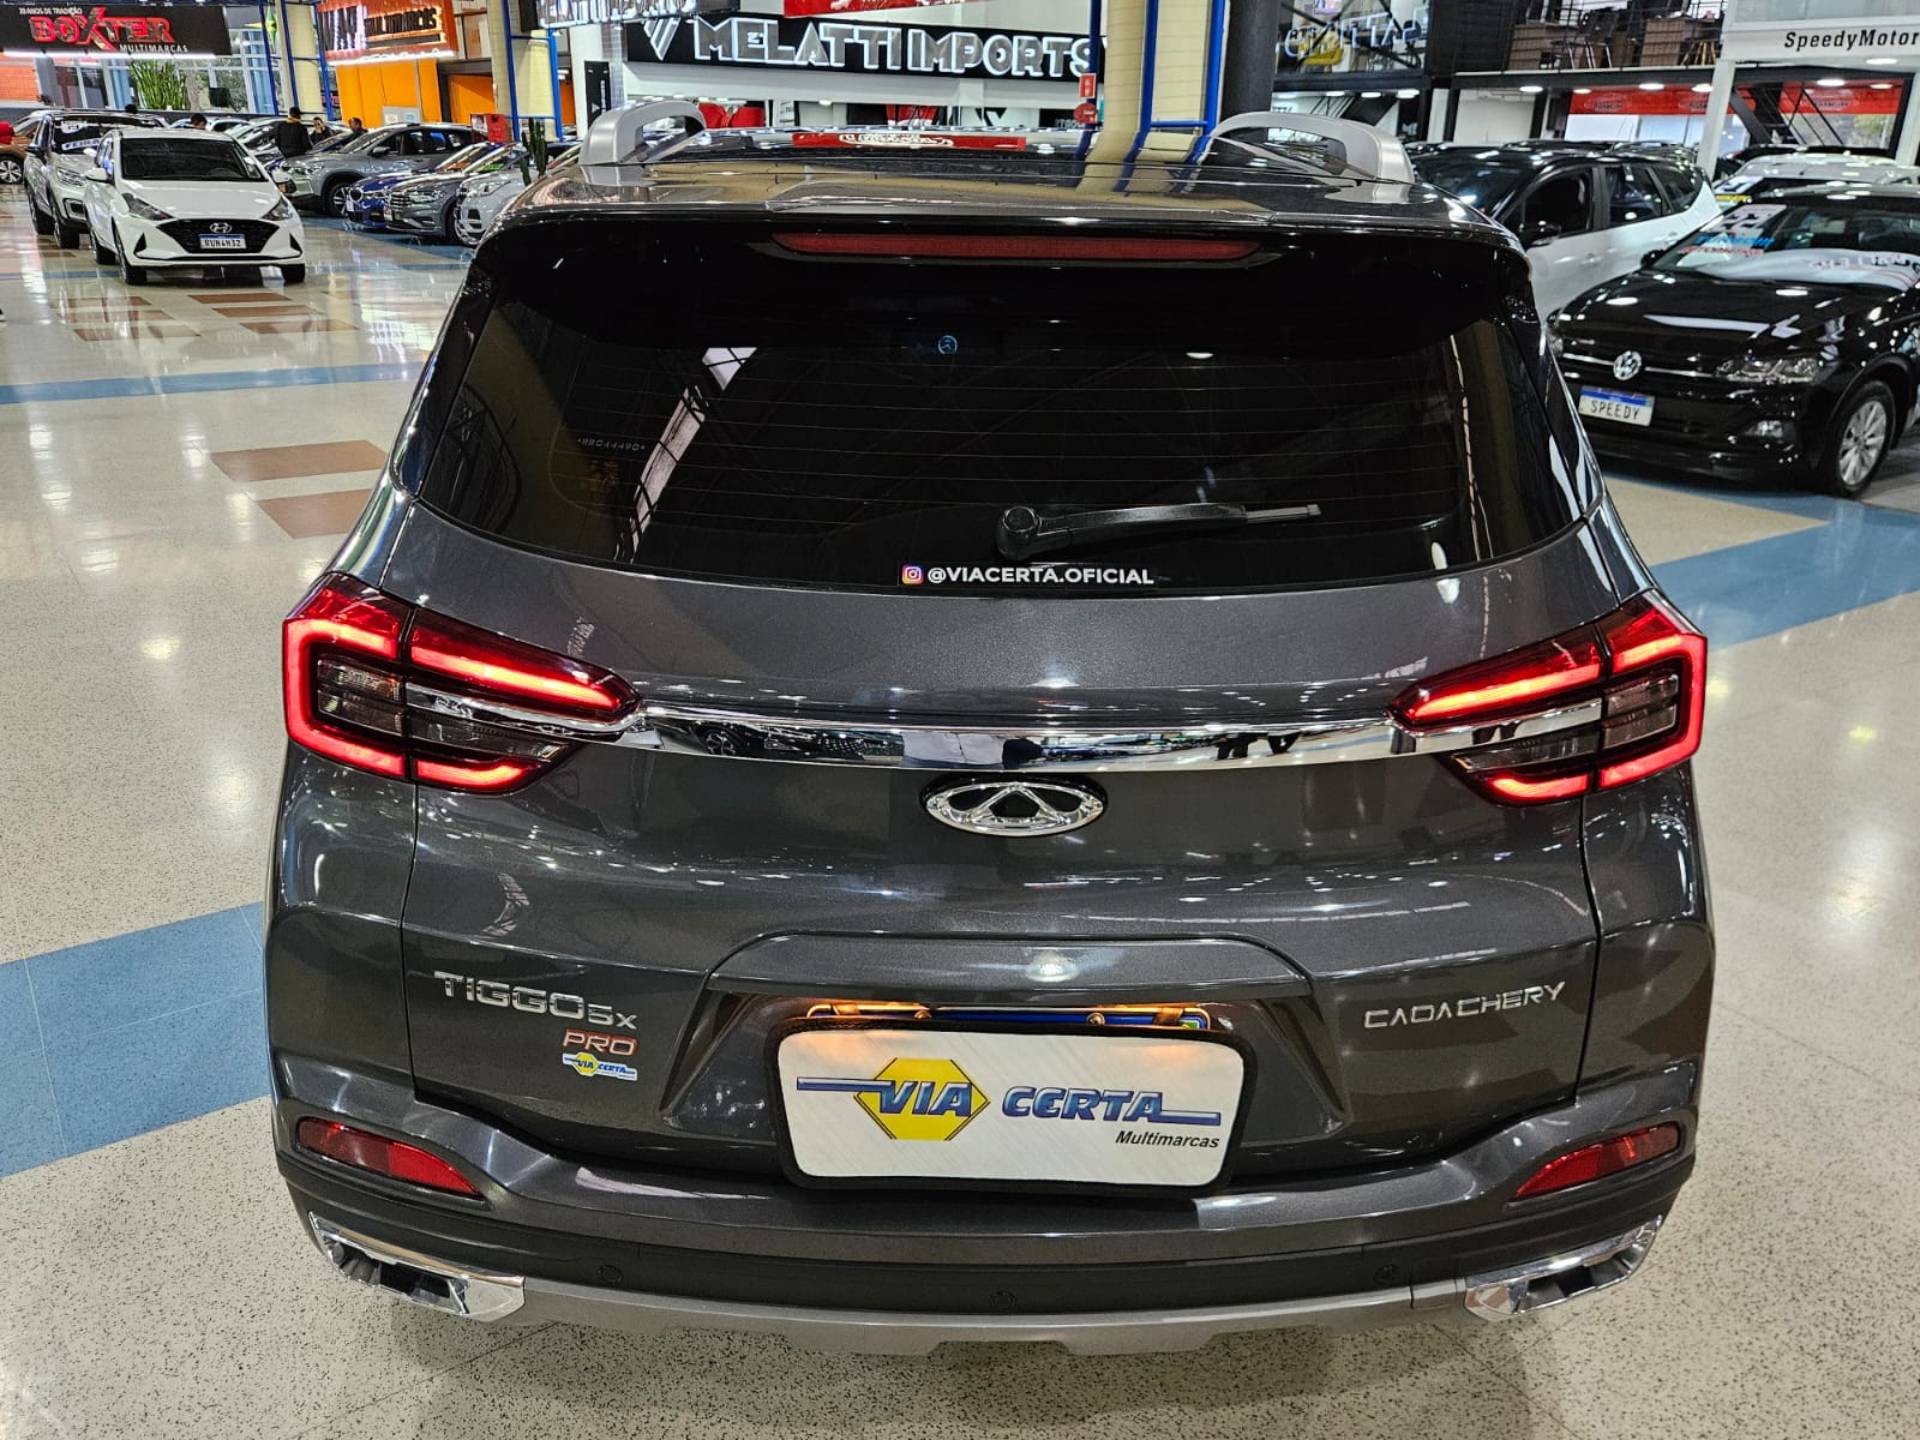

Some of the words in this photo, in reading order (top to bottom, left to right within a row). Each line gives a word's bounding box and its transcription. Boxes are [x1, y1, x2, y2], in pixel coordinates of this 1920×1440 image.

[28, 7, 175, 51] BOXTER
[119, 44, 188, 53] MULTIMARCAS
[693, 16, 901, 70] MELATTI
[907, 29, 1091, 77] IMPORTS
[1784, 29, 1919, 51] SpeedyMotor
[1591, 400, 1640, 419] SPEEDY
[927, 567, 1154, 584] @VIACERTA.OFICIAL
[563, 1031, 636, 1056] PRO
[598, 1063, 627, 1073] CERTA
[879, 1081, 972, 1116] VIA
[1001, 1086, 1164, 1123] CERTA
[1115, 1130, 1220, 1149] Multimarcas
